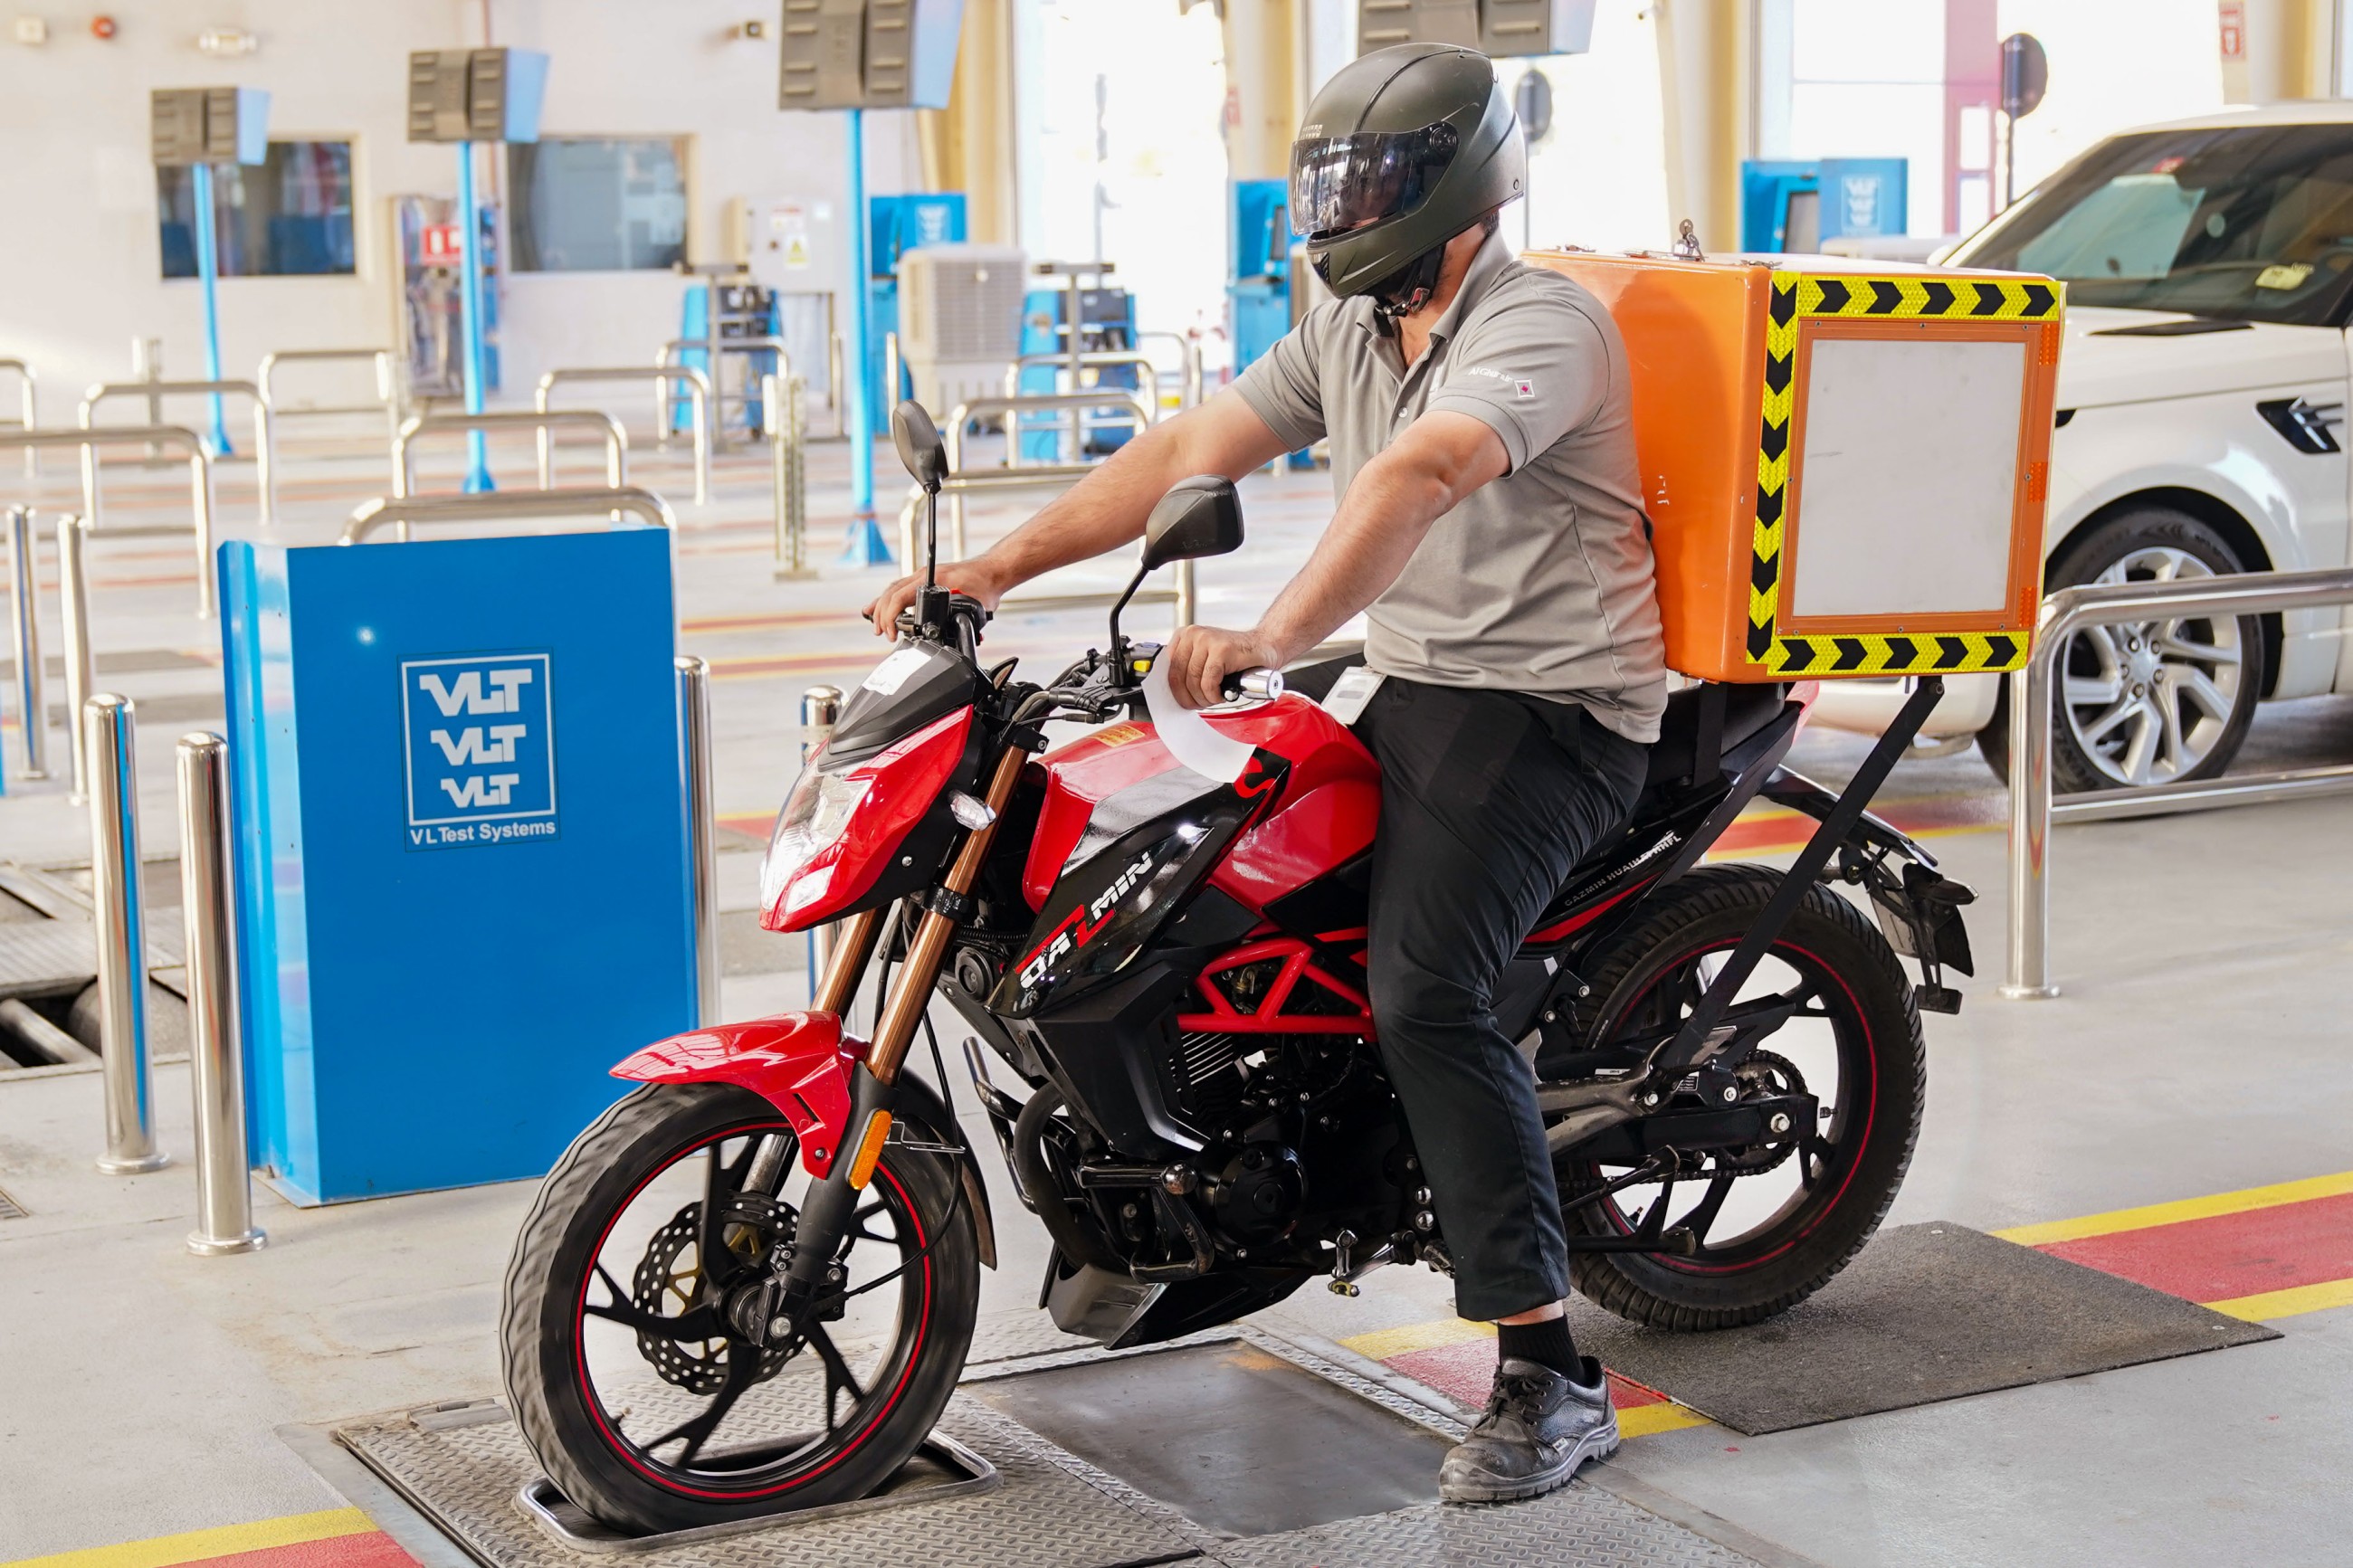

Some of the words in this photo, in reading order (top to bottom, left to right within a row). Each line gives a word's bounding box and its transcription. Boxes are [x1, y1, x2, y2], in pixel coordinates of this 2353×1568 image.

[419, 668, 533, 717] VLT
[430, 724, 527, 766] VLT
[440, 773, 519, 809] VLT
[437, 825, 475, 842] Test
[479, 821, 557, 843] Systems
[1564, 878, 1607, 907] GAZMIN
